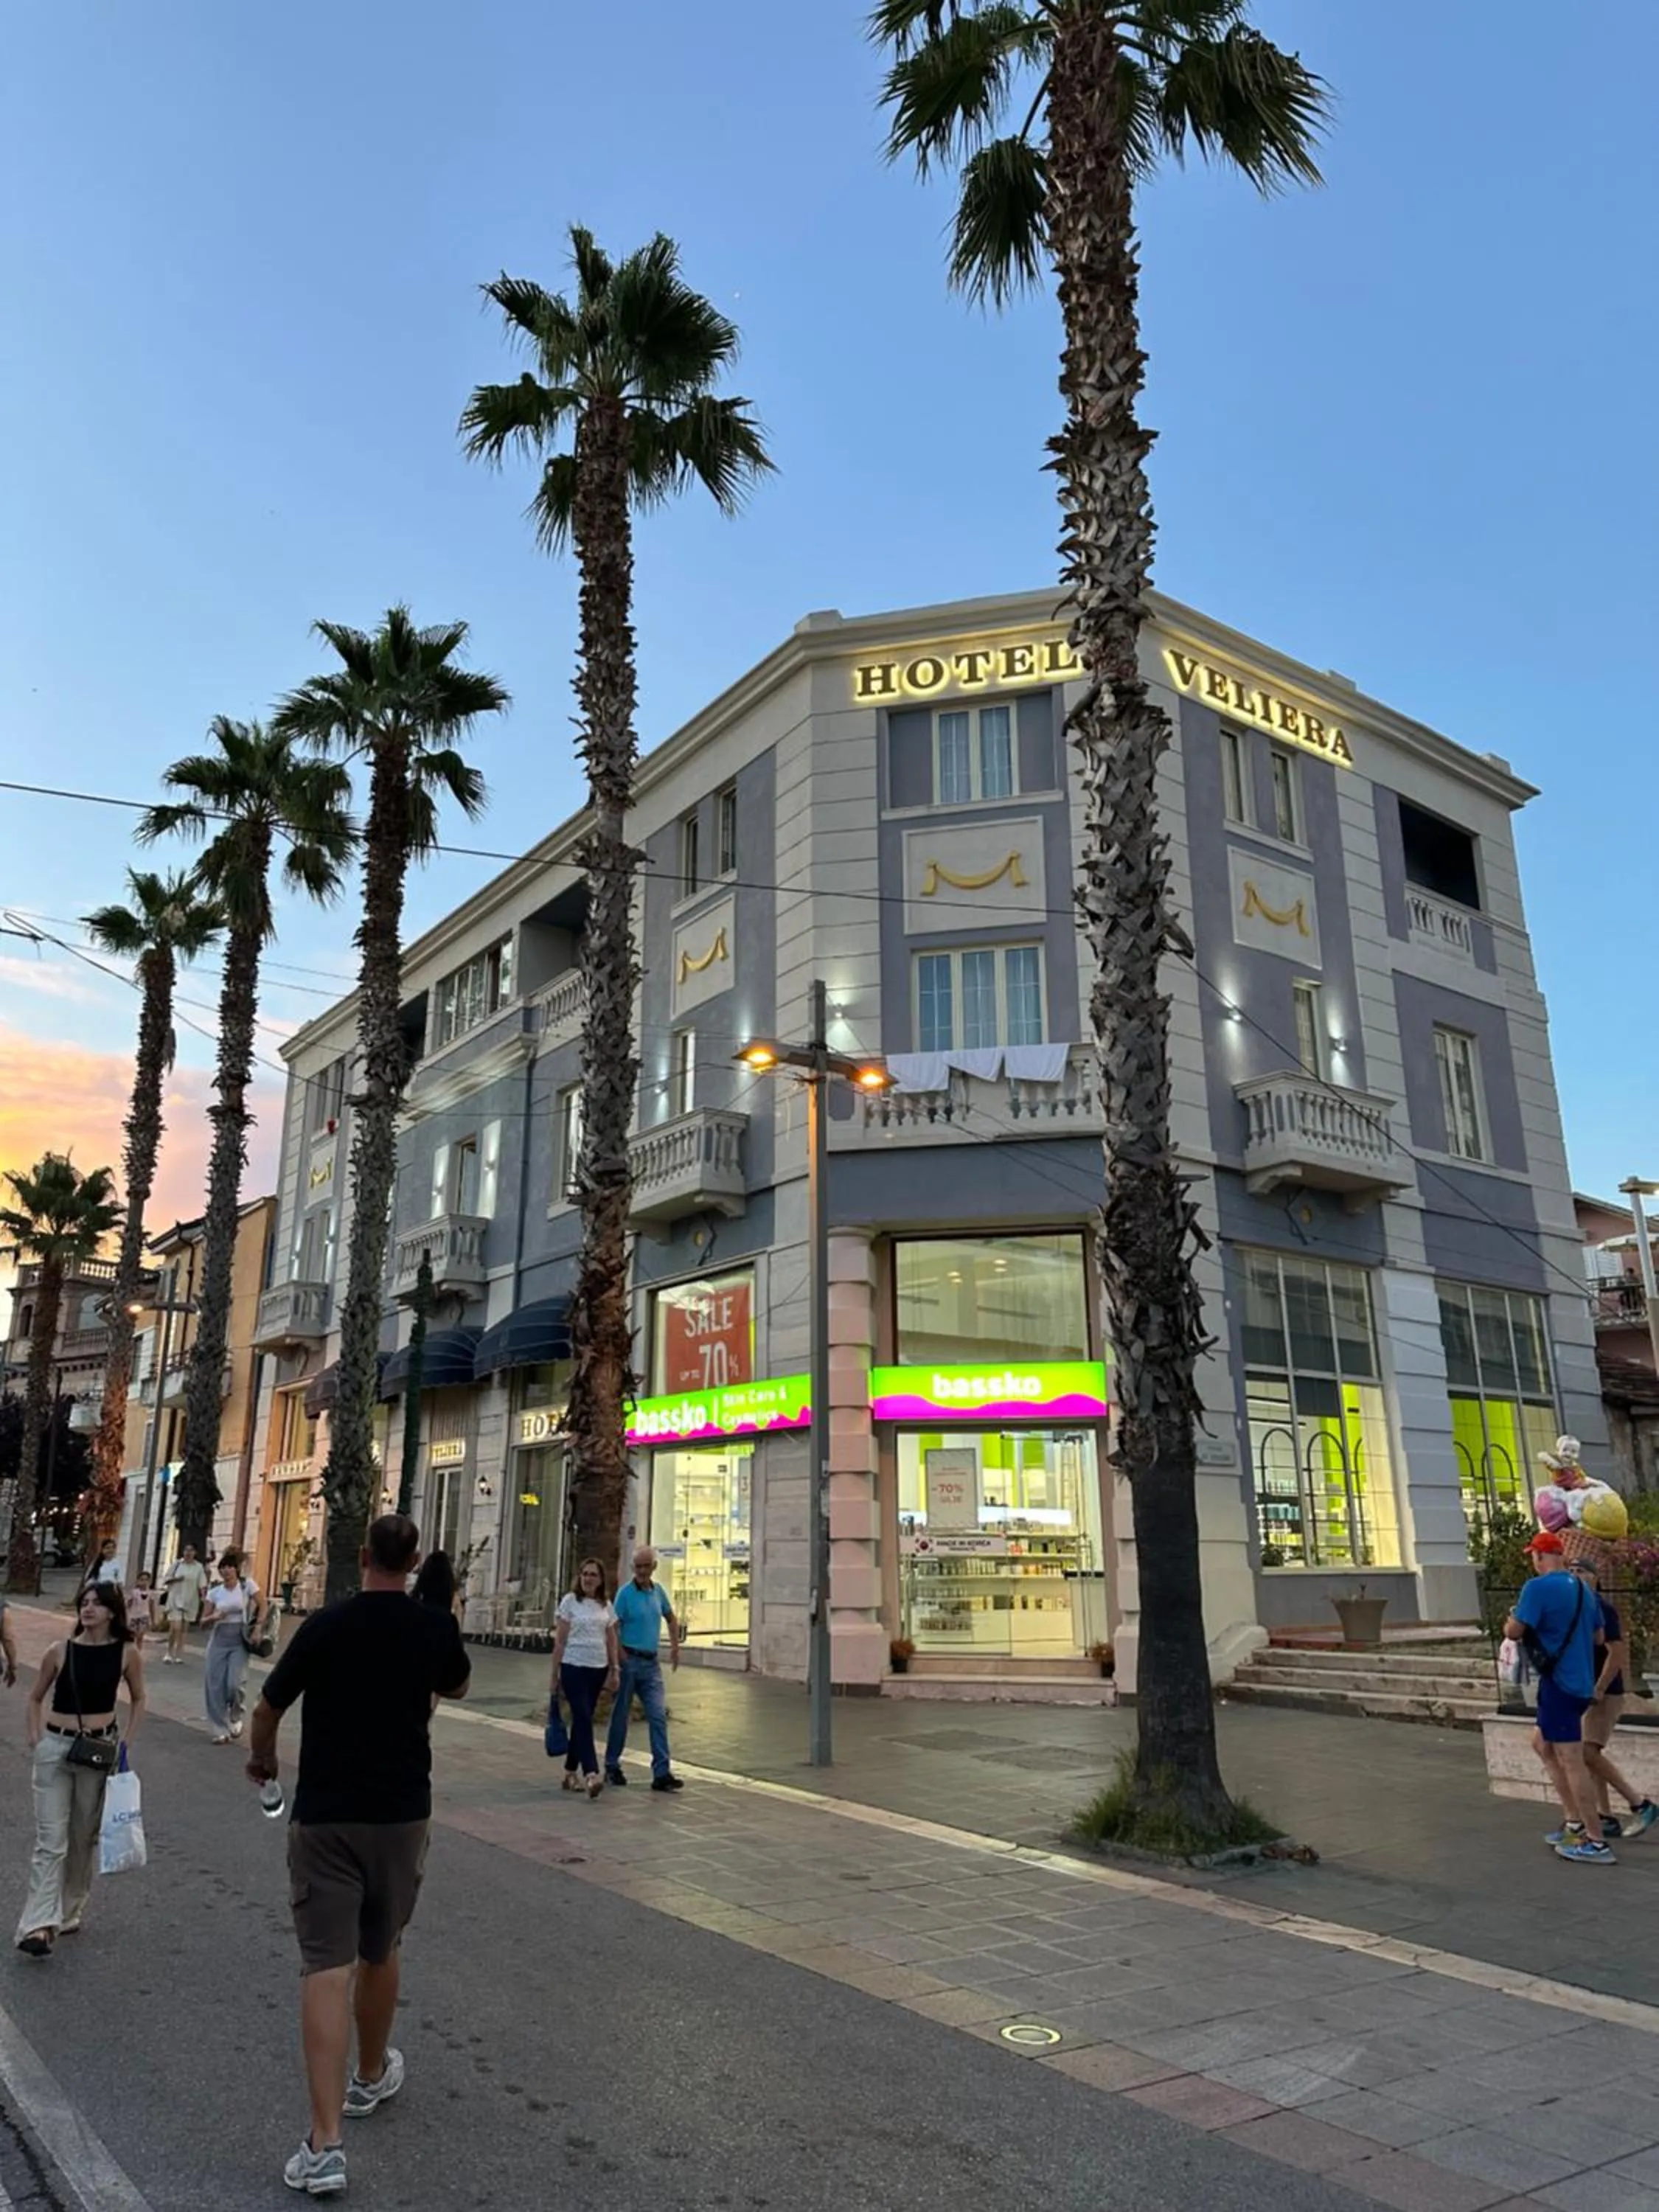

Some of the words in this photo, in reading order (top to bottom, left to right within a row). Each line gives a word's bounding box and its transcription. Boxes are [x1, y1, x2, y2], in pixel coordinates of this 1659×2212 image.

[856, 639, 1079, 698] HOTEL
[1168, 648, 1354, 762] VELIERA
[684, 1295, 734, 1338] SALE
[932, 1371, 1042, 1399] bassko
[521, 1411, 568, 1438] HOT
[635, 1399, 707, 1437] bassko
